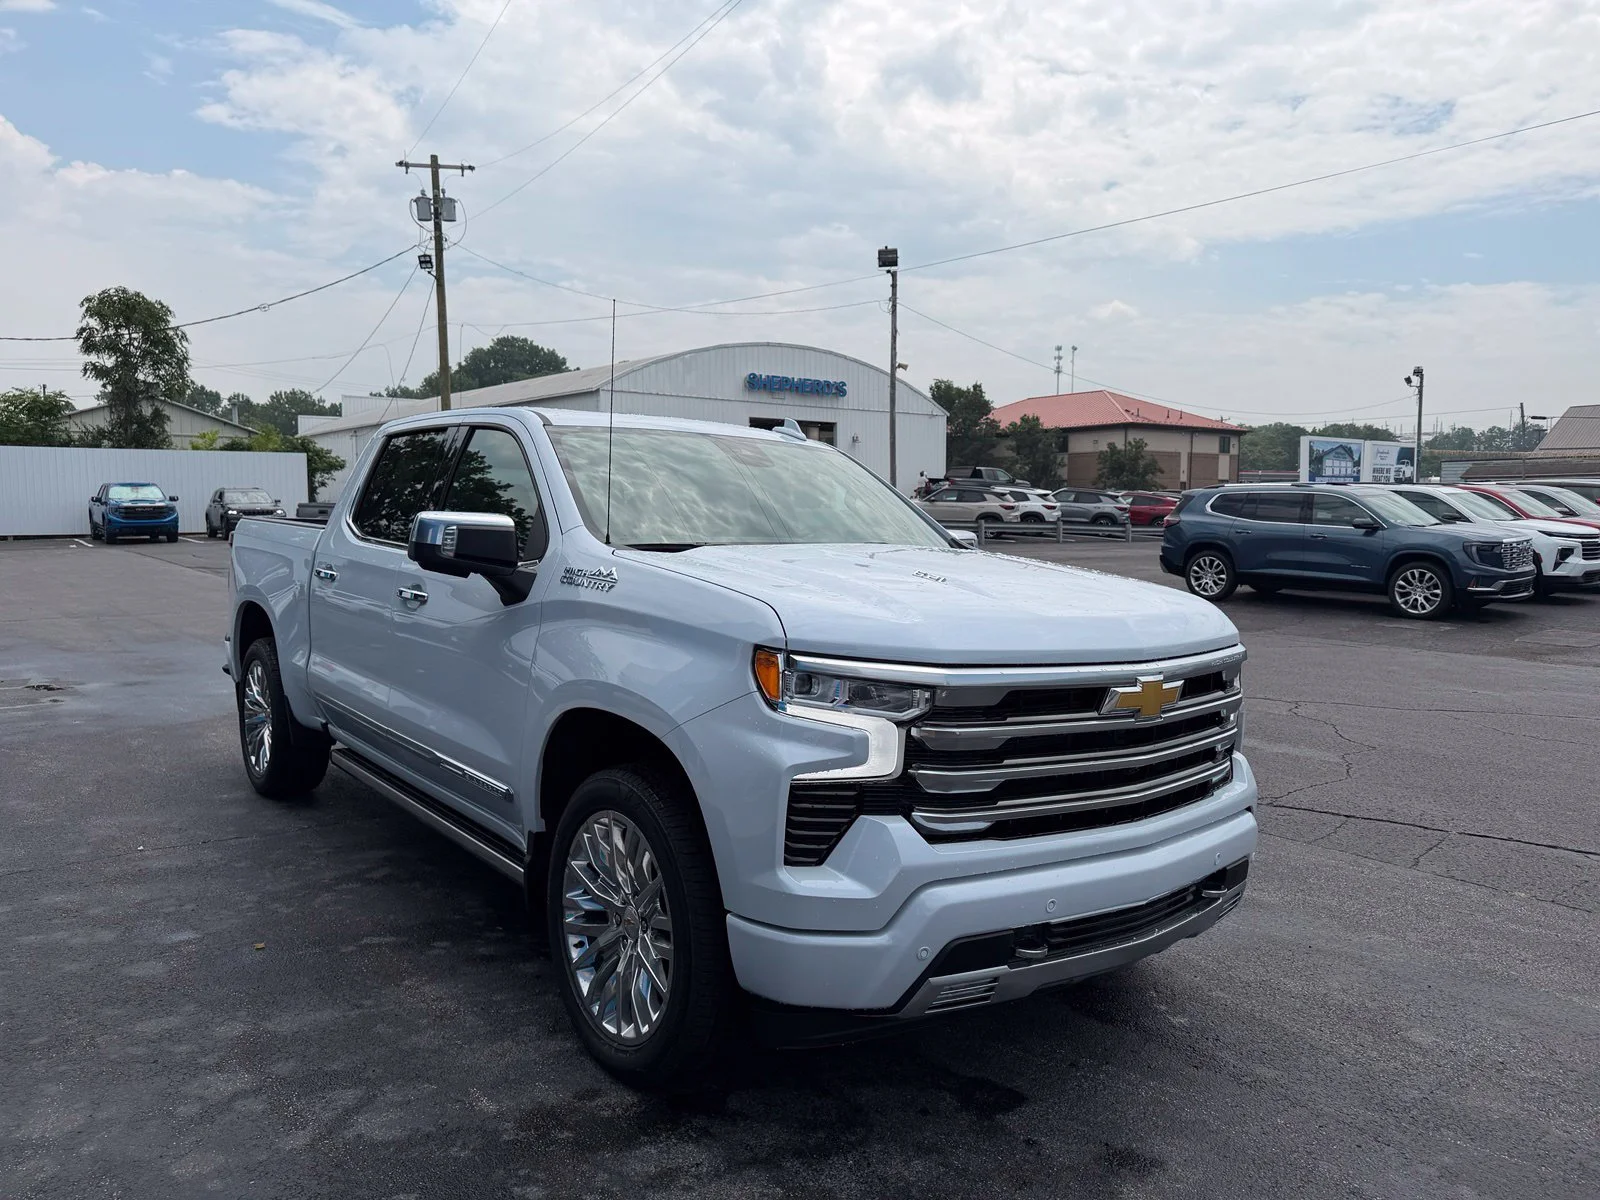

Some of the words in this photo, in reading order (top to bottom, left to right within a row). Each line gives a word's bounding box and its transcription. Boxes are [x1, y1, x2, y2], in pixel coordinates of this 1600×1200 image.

[746, 373, 848, 397] SHEPHERD'S
[563, 566, 589, 577] HIGH
[560, 575, 615, 592] COUNTRY
